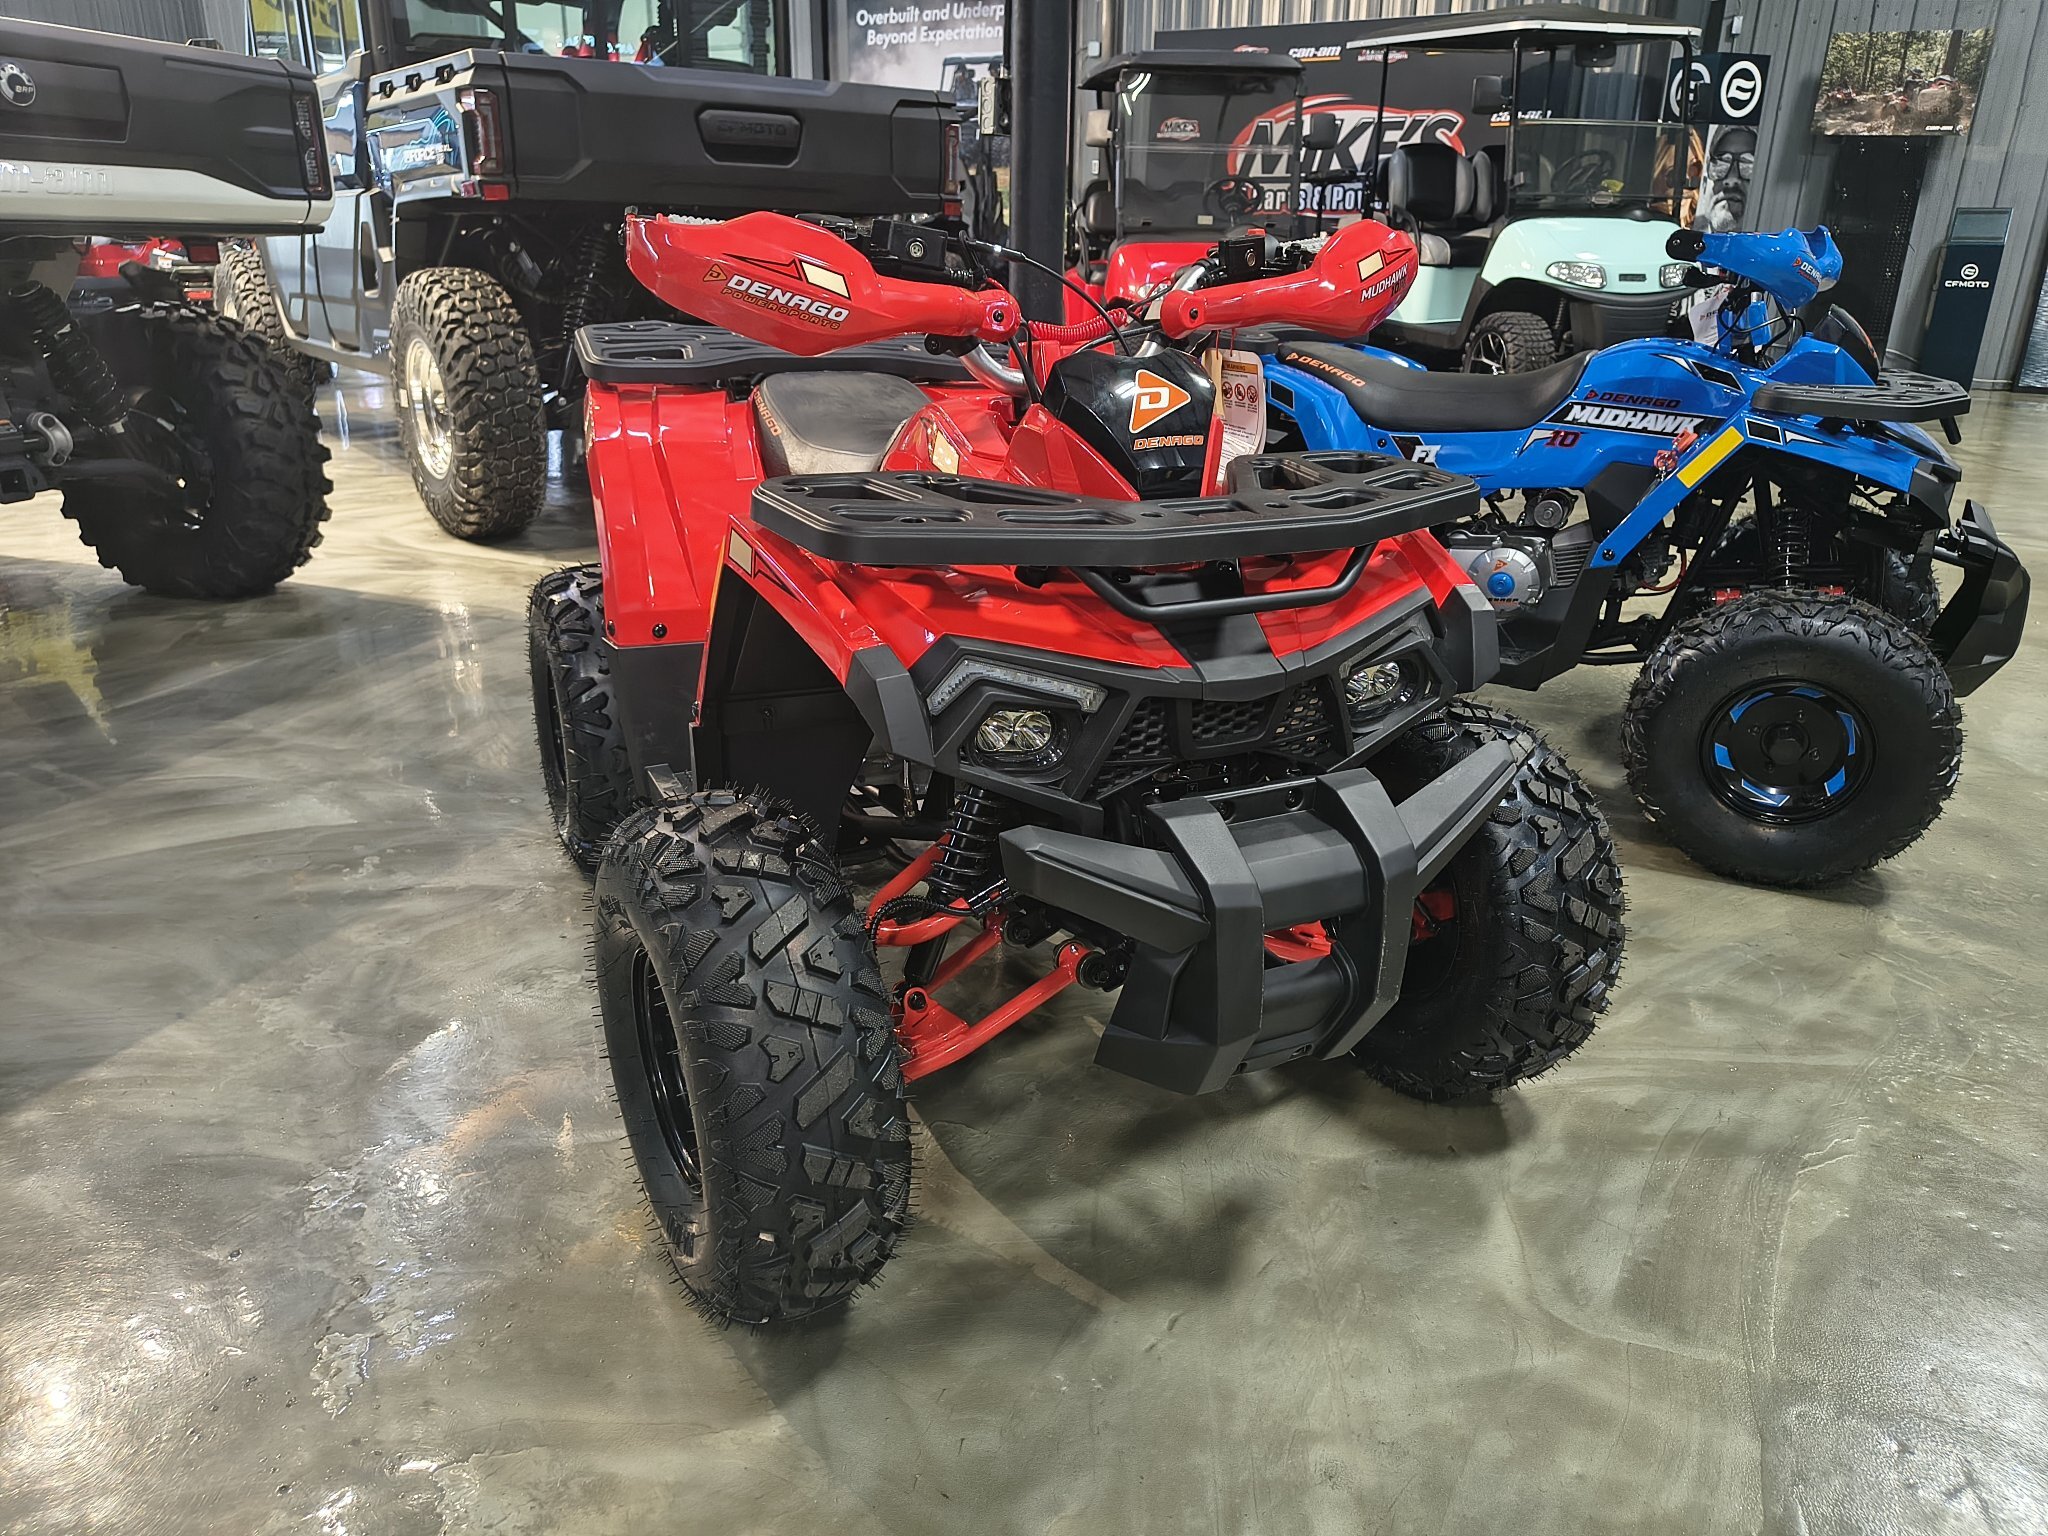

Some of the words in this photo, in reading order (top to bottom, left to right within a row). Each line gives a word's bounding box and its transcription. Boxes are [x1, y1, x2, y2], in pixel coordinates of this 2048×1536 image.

[856, 6, 919, 26] Overbuilt
[922, 3, 949, 21] and
[867, 26, 917, 49] Beyond
[920, 23, 1003, 46] Expectation
[15, 85, 34, 93] BRP
[1360, 263, 1408, 303] MUDHAWK
[721, 288, 841, 330] POWERSPORTS
[727, 274, 850, 323] DENAGO
[1298, 356, 1366, 387] DENAGO
[753, 391, 782, 436] DENAGO
[1600, 392, 1682, 409] DENAGO
[1564, 404, 1704, 434] MUDHAWK
[1133, 435, 1204, 451] DENAGO
[1545, 429, 1582, 448] 10
